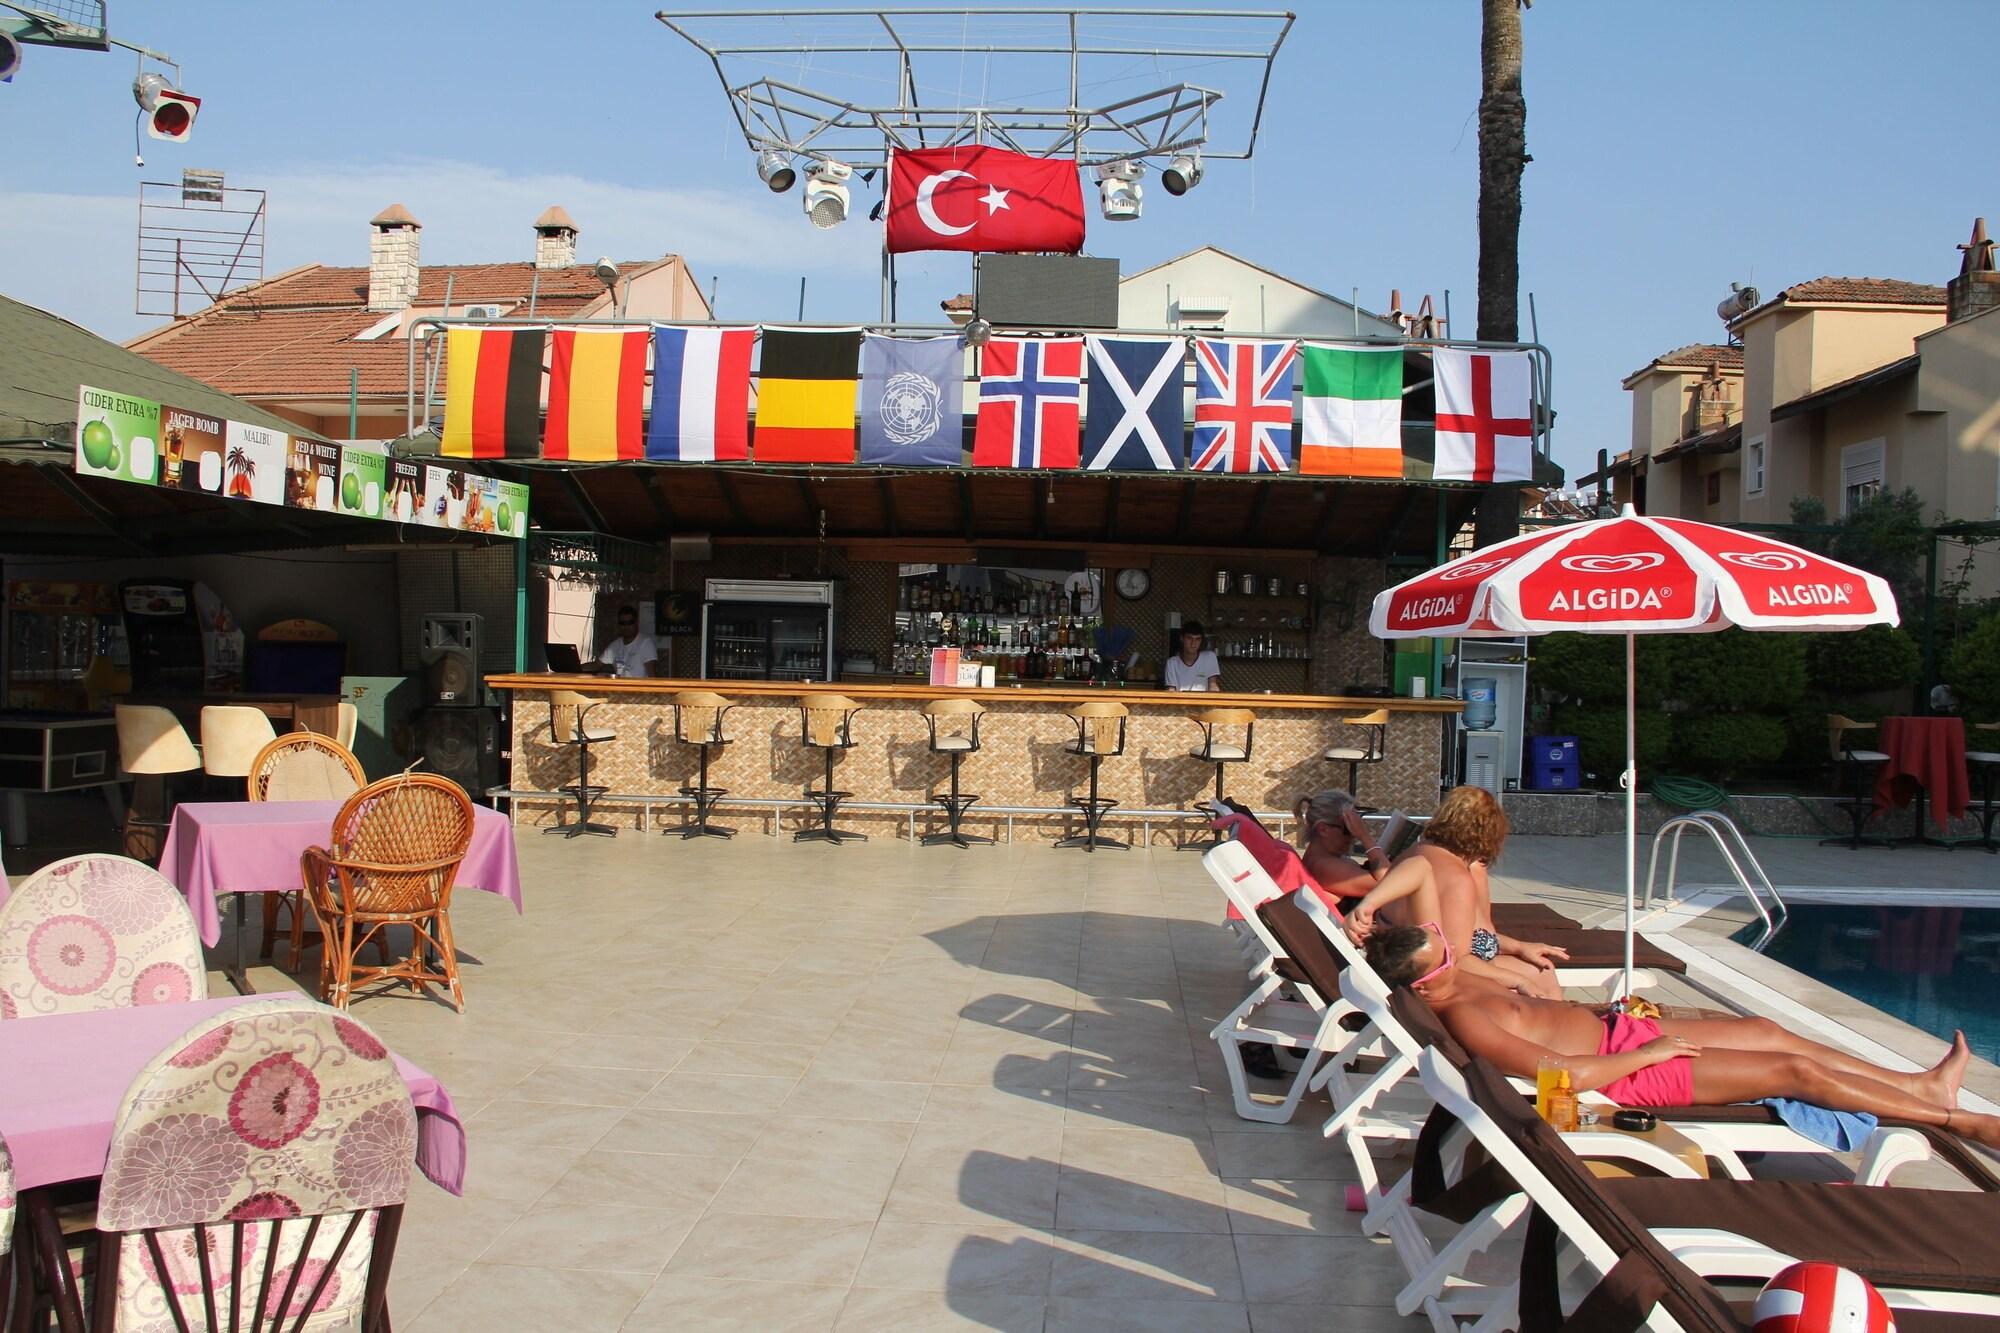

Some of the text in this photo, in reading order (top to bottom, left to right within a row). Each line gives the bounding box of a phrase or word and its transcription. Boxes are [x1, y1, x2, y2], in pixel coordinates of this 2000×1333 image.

[84, 391, 114, 411] CIDER
[116, 398, 145, 418] EXTRA
[169, 411, 219, 435] JAGER BOMB
[243, 428, 272, 446] MALIBU
[295, 440, 337, 459] RED & WHITE
[343, 450, 359, 465] CIDER
[360, 455, 377, 469] EXTRA
[318, 462, 336, 477] WINE
[394, 462, 418, 477] FREEZER
[429, 469, 441, 481] EFES
